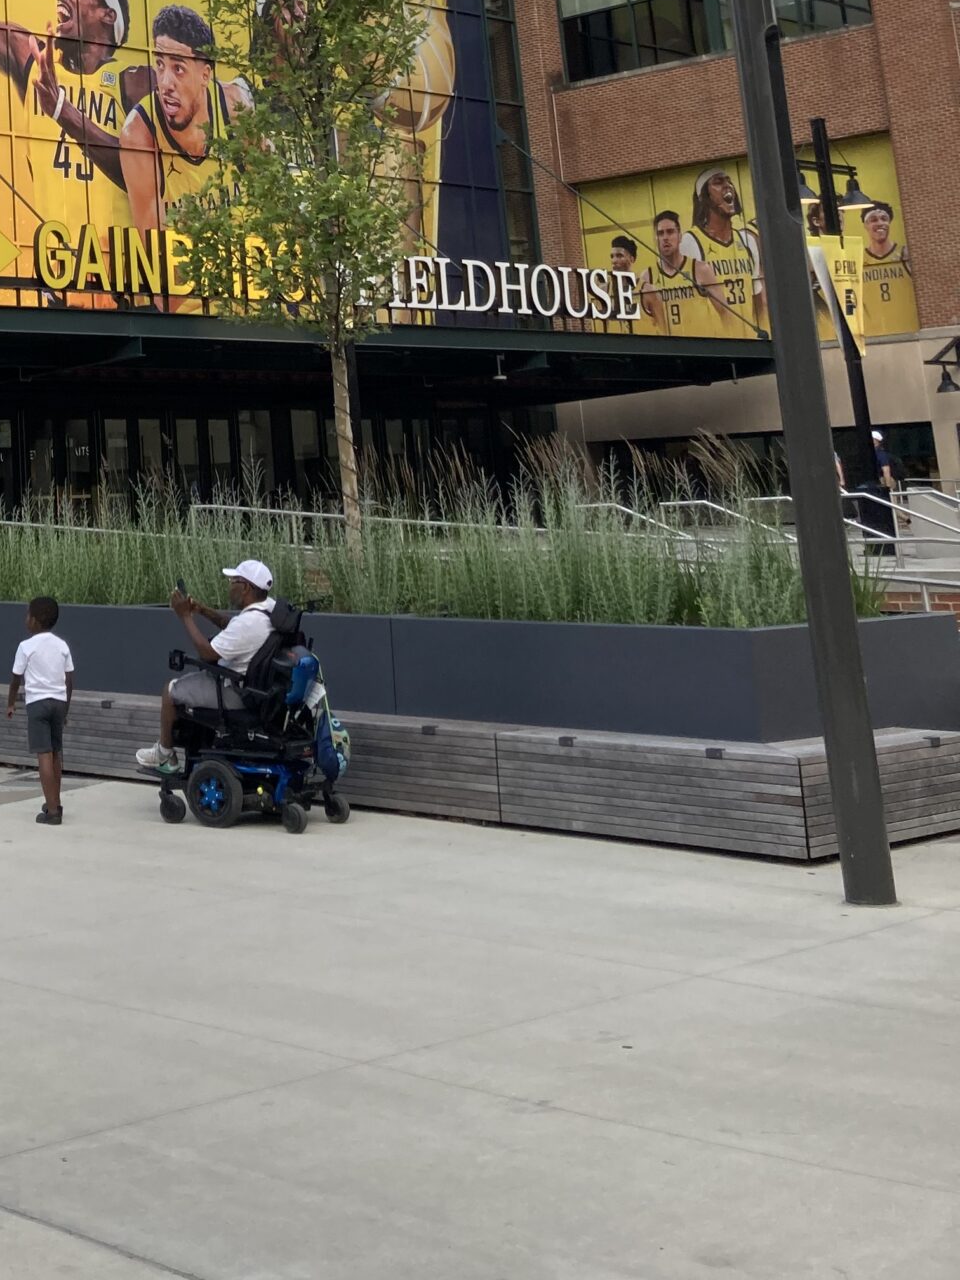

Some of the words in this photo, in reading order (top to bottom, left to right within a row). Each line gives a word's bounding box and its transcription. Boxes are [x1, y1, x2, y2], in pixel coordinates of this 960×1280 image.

[34, 84, 117, 131] IIANA
[708, 257, 754, 276] NDIANA
[354, 255, 641, 320] IELDHOUSE
[661, 285, 695, 302] DIANA
[723, 278, 746, 305] 33
[880, 282, 891, 303] 8
[671, 303, 682, 325] 9
